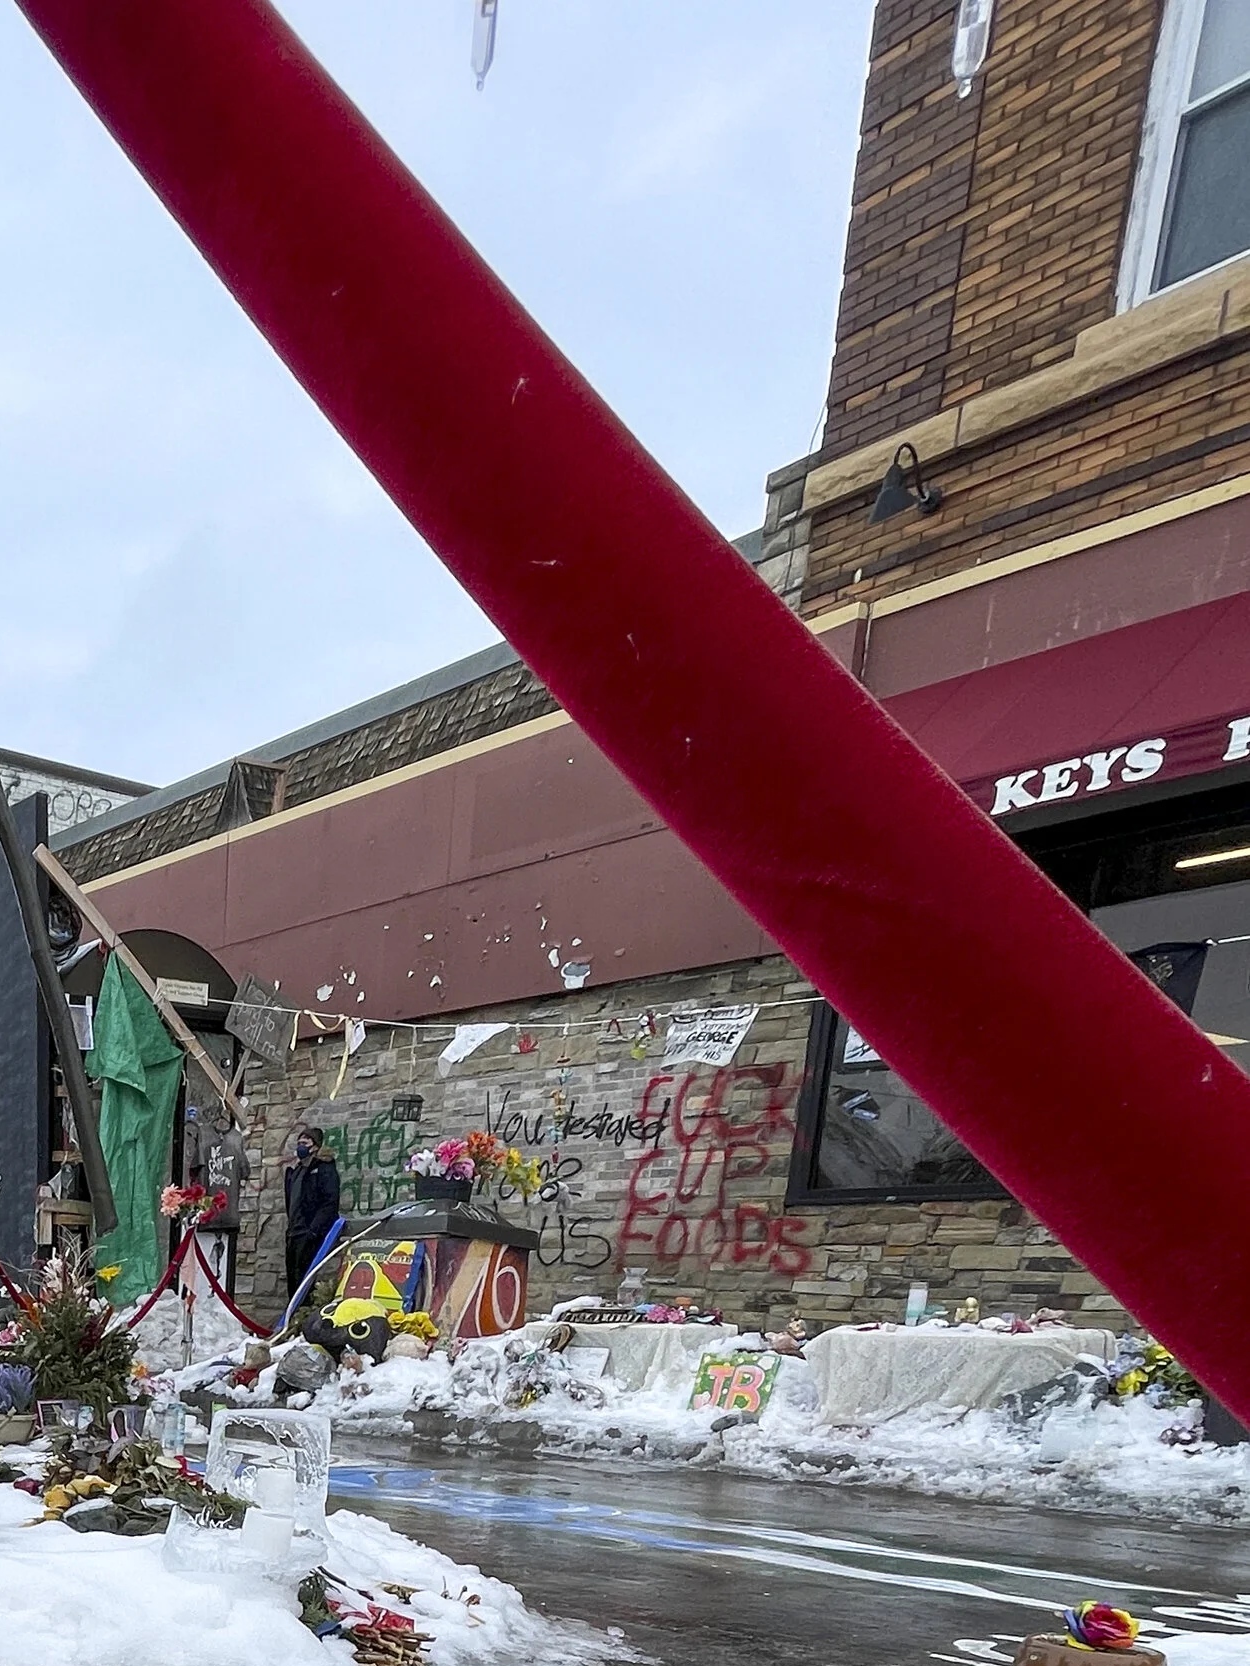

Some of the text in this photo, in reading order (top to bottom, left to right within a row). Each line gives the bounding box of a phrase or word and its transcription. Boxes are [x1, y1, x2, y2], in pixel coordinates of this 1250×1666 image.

[990, 738, 1167, 816] KEYS
[686, 1031, 739, 1045] GEORGE
[629, 1140, 771, 1210] CUP
[536, 1214, 612, 1269] US
[615, 1202, 813, 1276] FOODS
